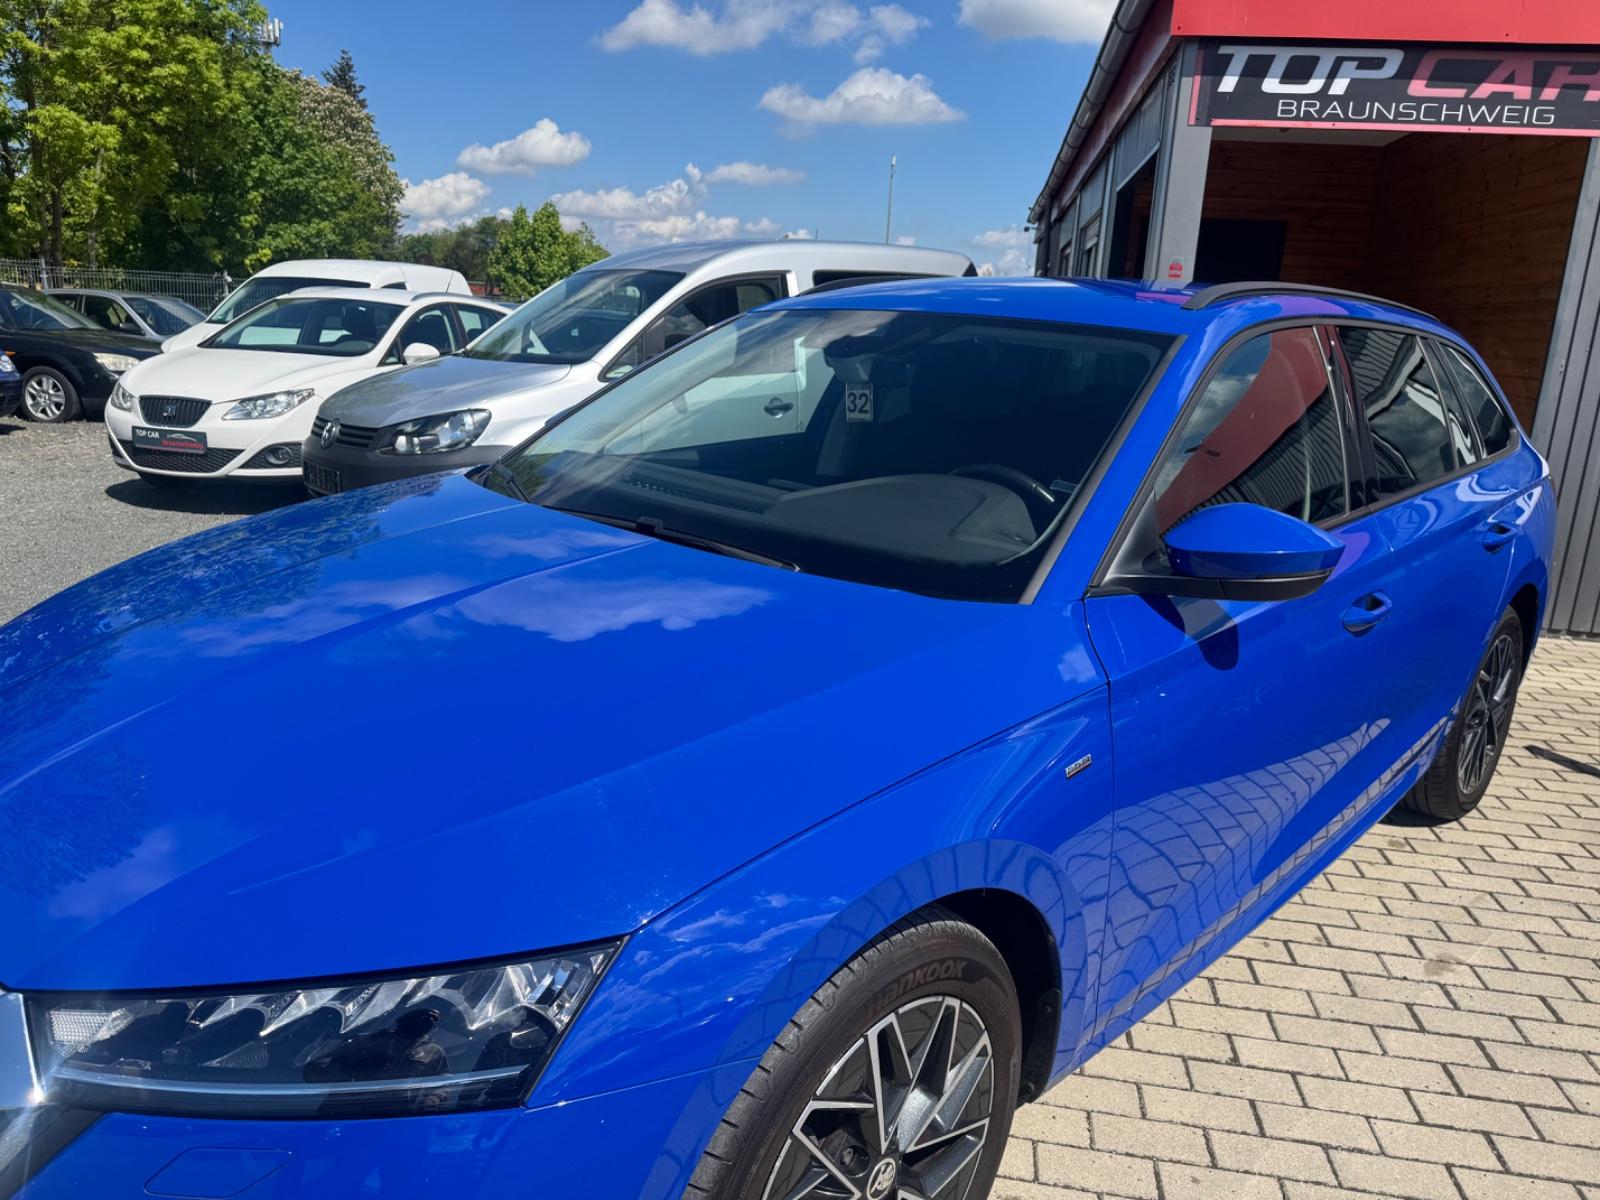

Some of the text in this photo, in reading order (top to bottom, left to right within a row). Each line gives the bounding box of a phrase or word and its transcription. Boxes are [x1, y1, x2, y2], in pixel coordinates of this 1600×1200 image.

[1217, 45, 1405, 95] TOP
[1276, 99, 1556, 125] BRAUNSCHWEIG
[847, 391, 869, 414] 32
[135, 428, 160, 439] TOP CAR
